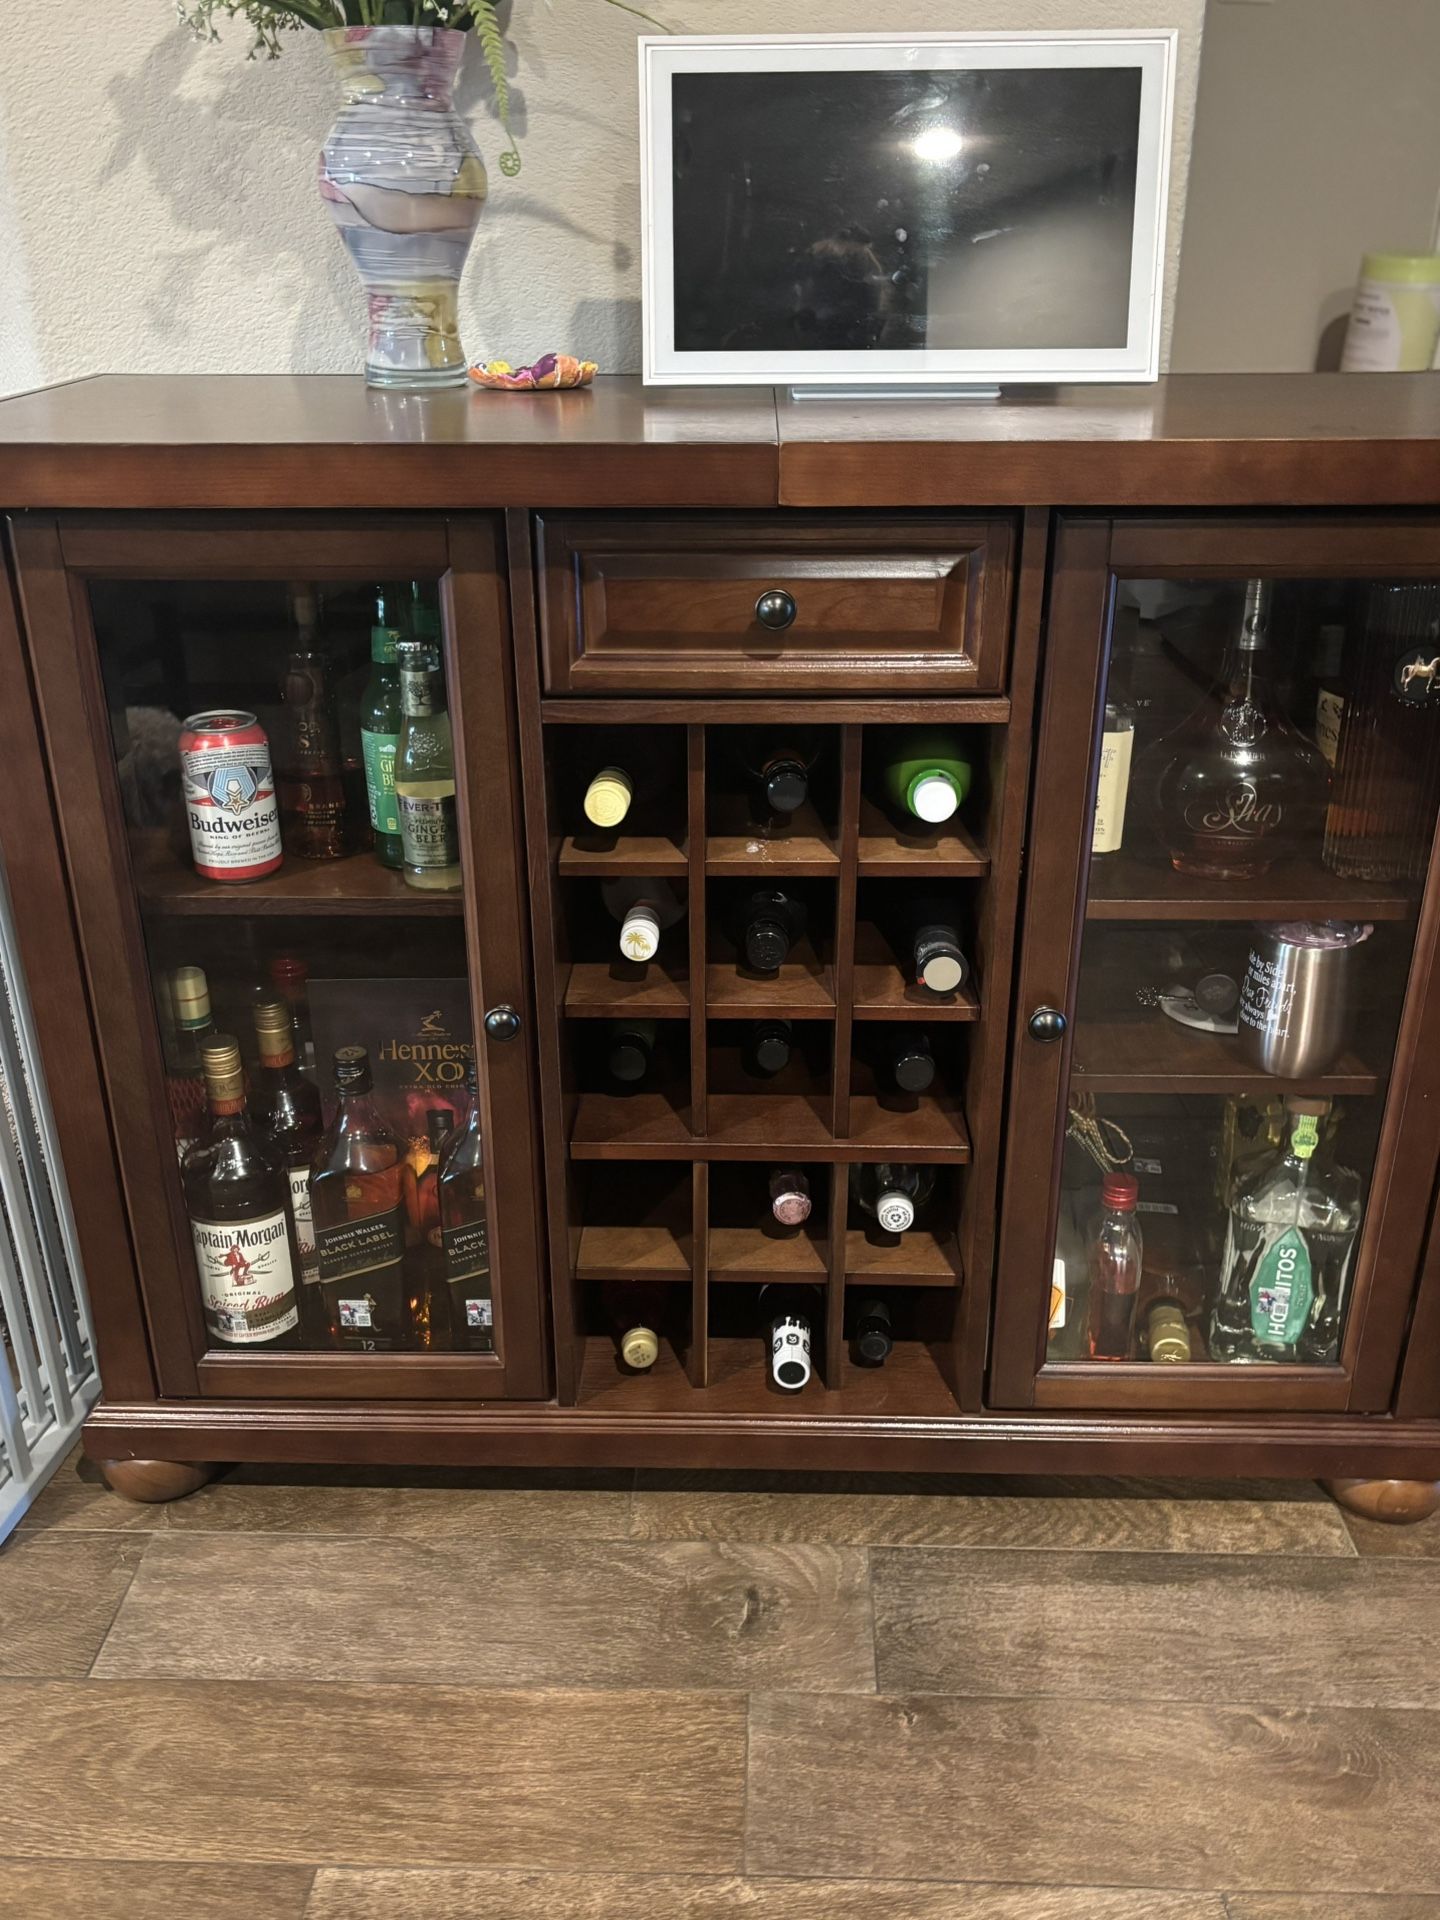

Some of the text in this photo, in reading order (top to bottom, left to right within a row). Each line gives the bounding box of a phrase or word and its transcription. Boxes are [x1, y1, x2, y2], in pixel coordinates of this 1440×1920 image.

[232, 1221, 285, 1247] Morgan
[324, 1232, 355, 1246] JOHNNIE
[320, 1231, 395, 1257] BLACK LABEL
[448, 1239, 487, 1256] BLACK
[252, 1291, 285, 1310] Rum
[361, 1340, 376, 1351] 12
